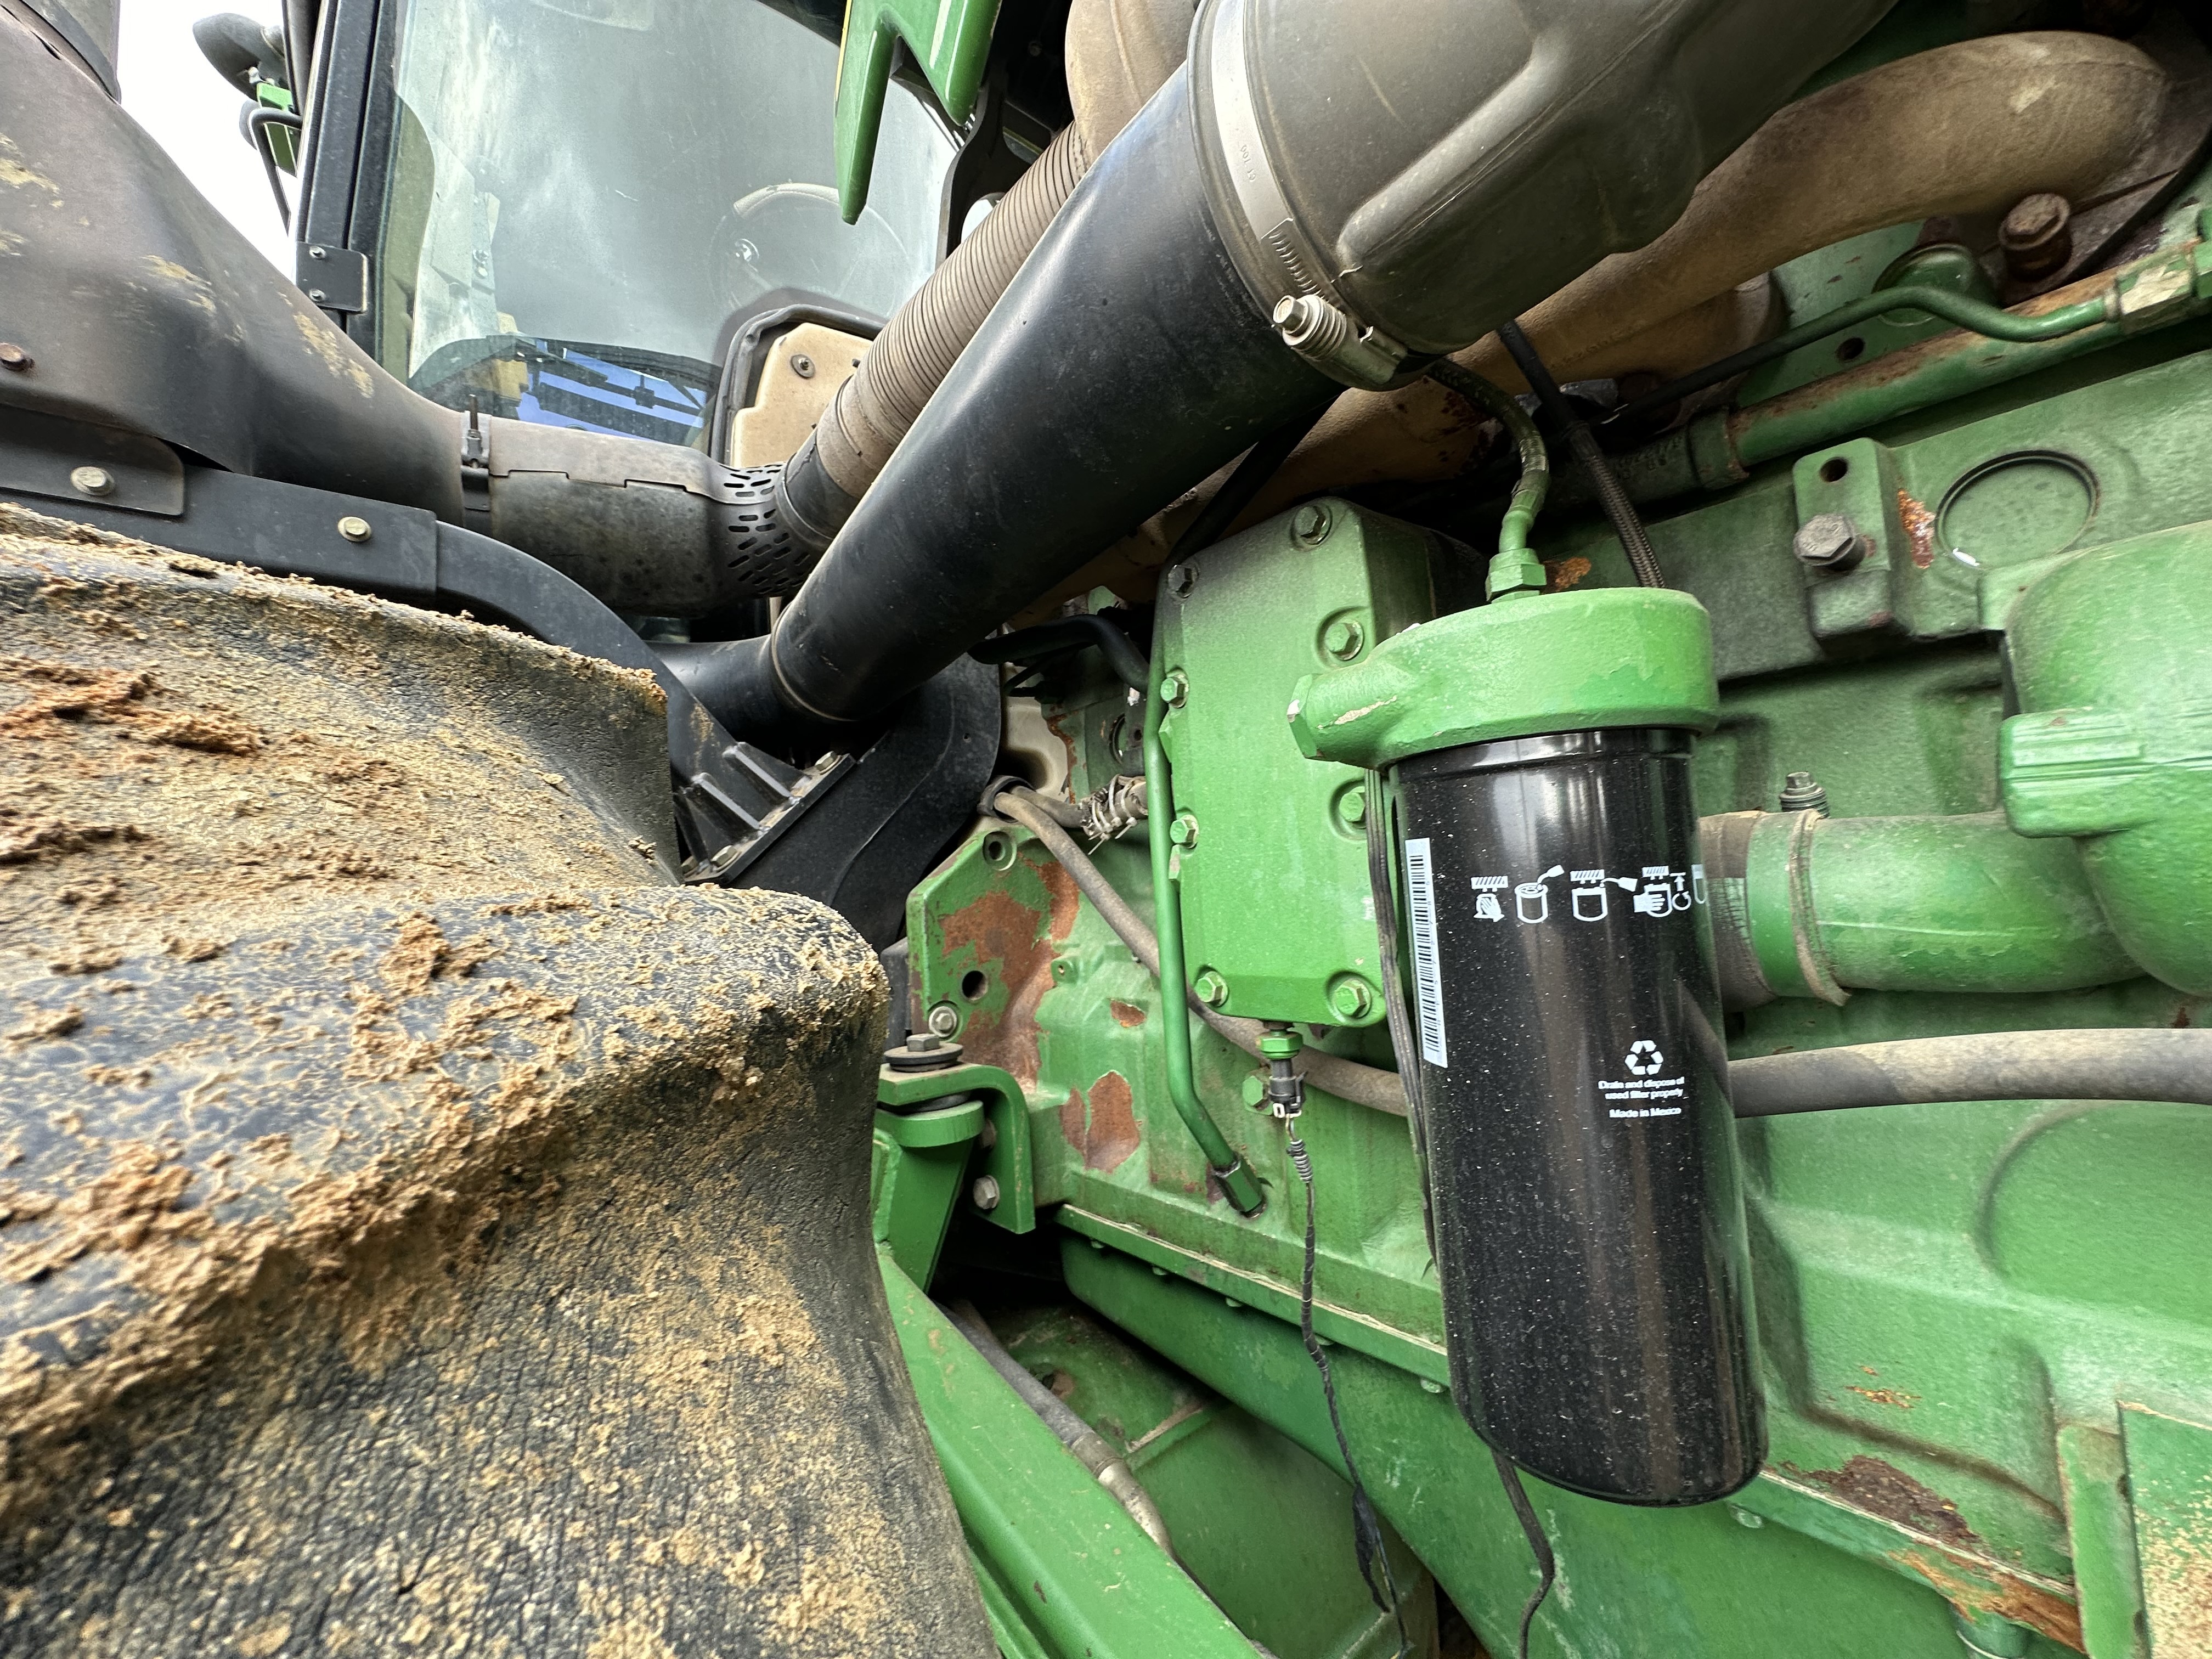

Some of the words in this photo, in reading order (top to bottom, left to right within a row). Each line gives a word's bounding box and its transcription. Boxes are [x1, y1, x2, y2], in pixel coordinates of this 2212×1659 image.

[1609, 1109, 1639, 1118] Made
[1639, 1108, 1650, 1118] in
[1650, 1107, 1682, 1117] Mexico
